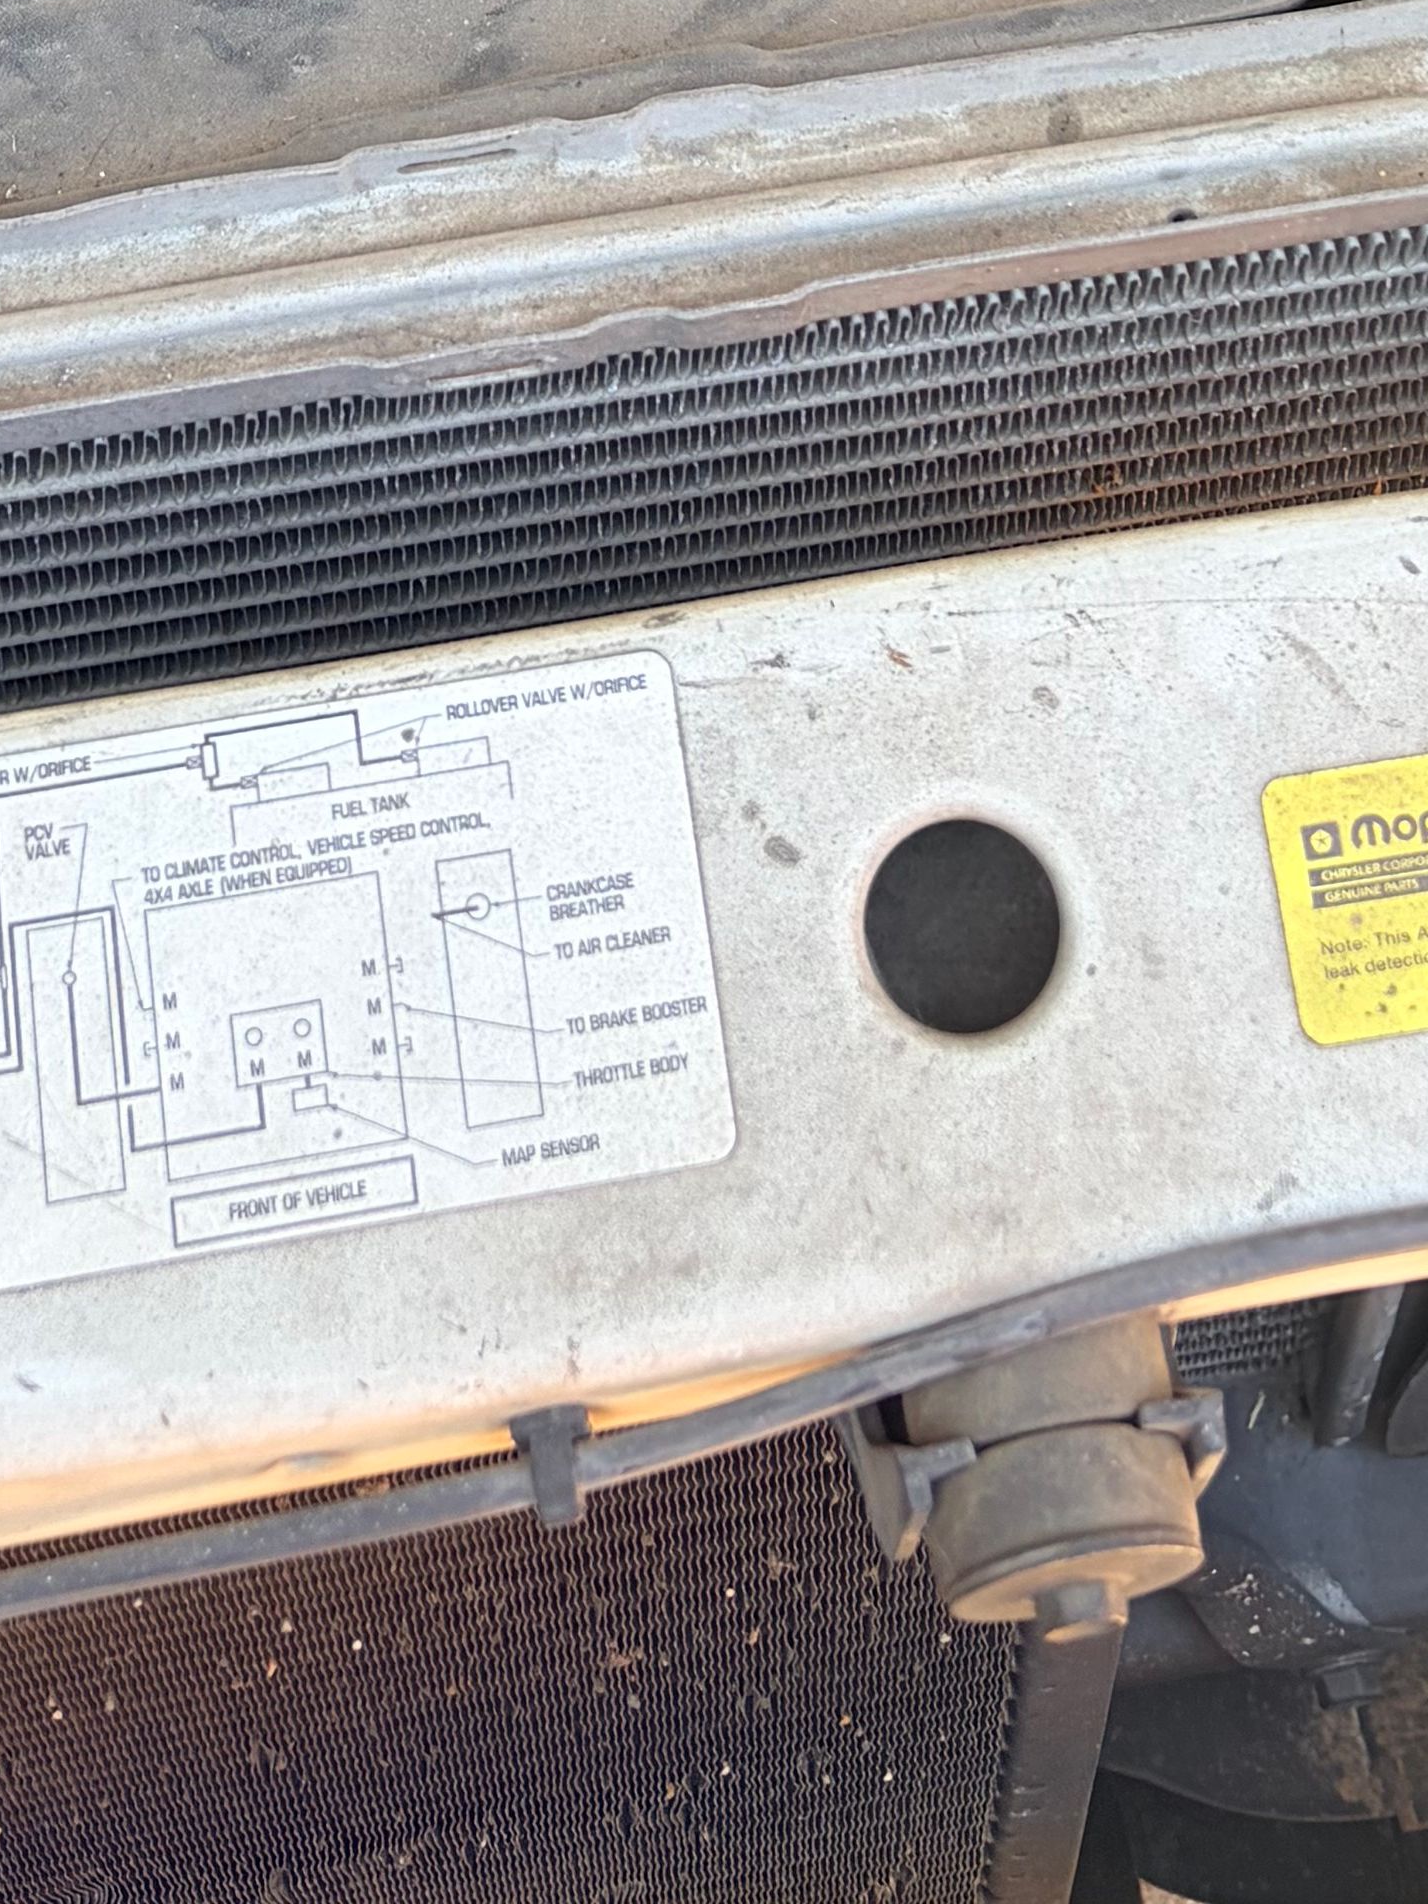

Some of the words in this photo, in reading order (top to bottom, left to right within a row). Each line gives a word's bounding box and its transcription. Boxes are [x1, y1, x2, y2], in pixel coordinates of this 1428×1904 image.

[445, 694, 518, 720] ROLLOVER
[521, 685, 567, 708] VALVE
[569, 673, 647, 700] W/ORIFICE
[330, 799, 367, 820] FUEL
[369, 791, 410, 813] TANK
[140, 865, 161, 883] TO
[163, 853, 226, 880] CLIMATE
[229, 842, 301, 869] CONTROL,
[306, 830, 366, 856] VEHICLE
[369, 822, 416, 846] SPEED
[419, 812, 491, 837] CONTROL,
[545, 871, 634, 901] CRANKCASE
[1321, 861, 1381, 882] CHRYSLER
[143, 885, 173, 903] 4X4
[177, 877, 213, 899] AXLE
[1324, 881, 1381, 904] GENUINE
[1383, 877, 1420, 894] PARTS
[549, 894, 625, 921] BREATHER
[1372, 930, 1412, 948] This
[501, 1143, 536, 1167] MAP
[540, 1133, 600, 1160] SENSOR
[228, 1194, 277, 1221] FRONT
[281, 1190, 301, 1211] OF
[305, 1179, 366, 1207] VEHICLE
